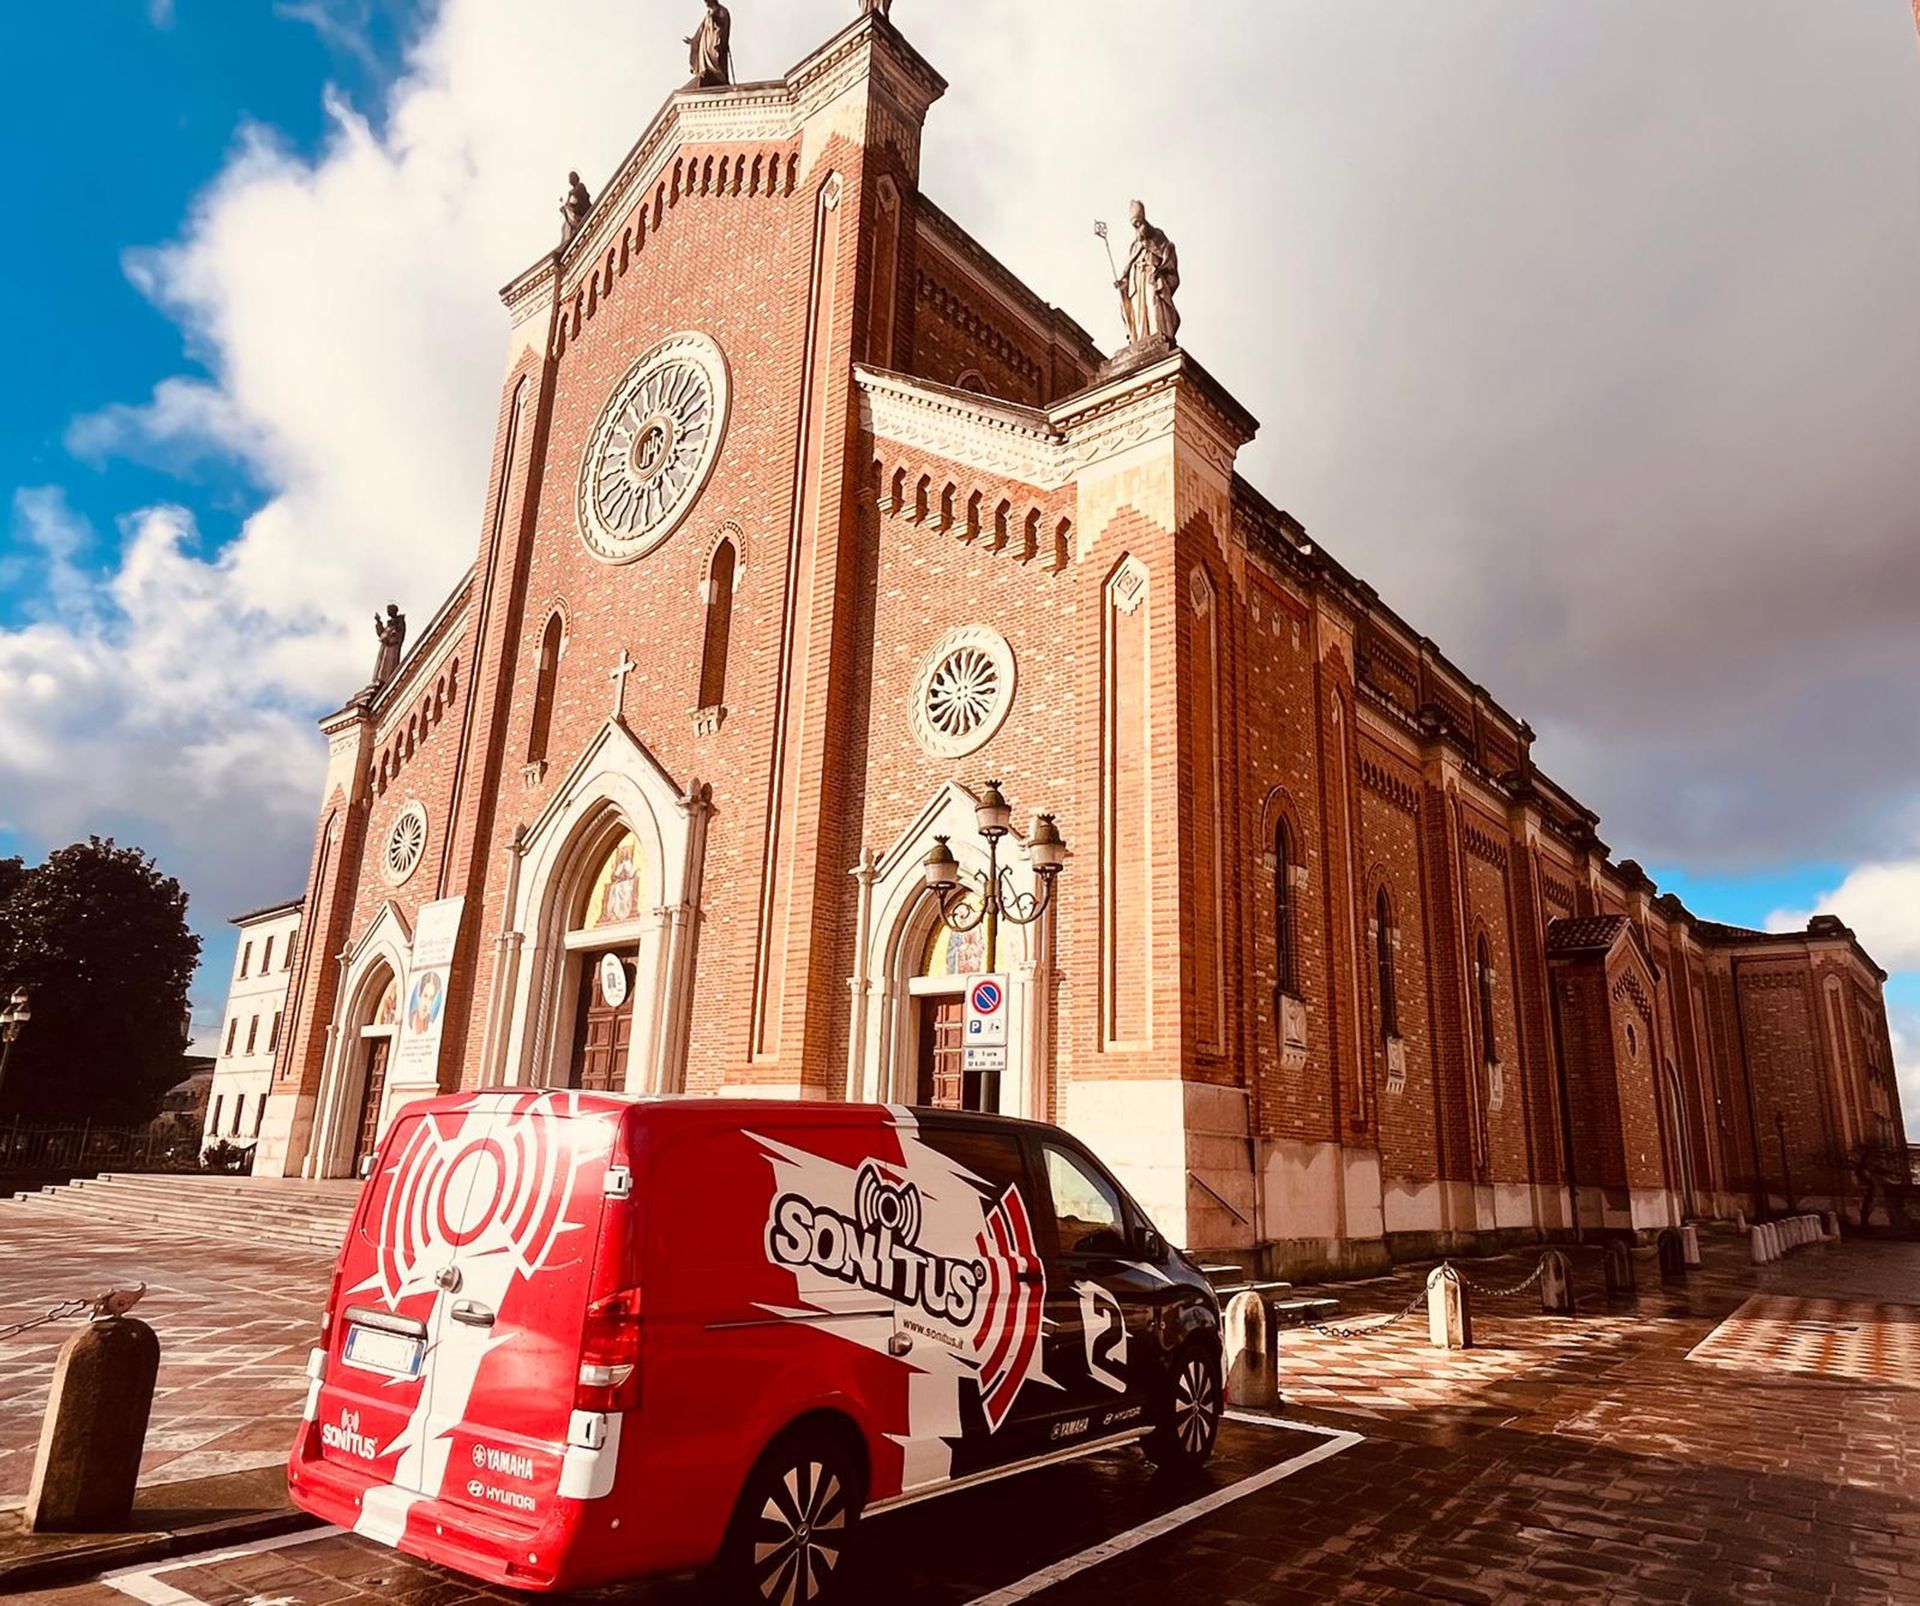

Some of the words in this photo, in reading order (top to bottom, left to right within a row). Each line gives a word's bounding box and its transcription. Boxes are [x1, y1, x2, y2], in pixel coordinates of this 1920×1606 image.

[771, 1195, 982, 1325] SONITUS
[903, 1319, 964, 1350] www.sonitus.it
[322, 1423, 376, 1460] SONITUS
[486, 1447, 534, 1481] YAMAHA
[486, 1485, 536, 1512] HYUNDAI
